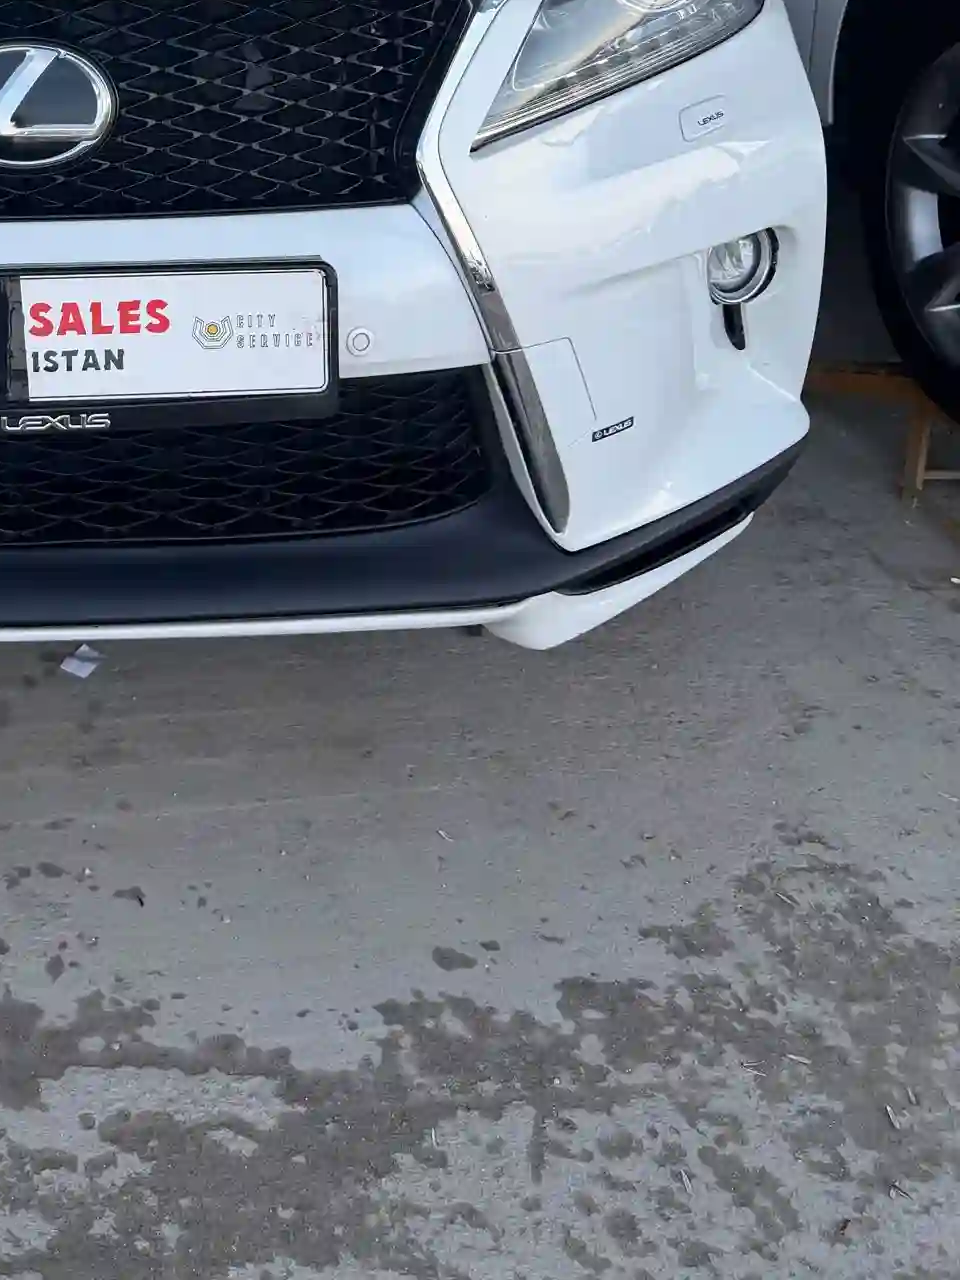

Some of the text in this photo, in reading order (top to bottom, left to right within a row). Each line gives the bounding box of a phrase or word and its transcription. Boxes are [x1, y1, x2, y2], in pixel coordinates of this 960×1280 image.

[697, 110, 724, 126] LEXUS
[28, 299, 171, 338] SALES
[236, 314, 276, 328] CITY
[236, 333, 314, 349] SERVICE
[1, 413, 111, 432] LEXUS
[603, 419, 632, 436] LEXUS
